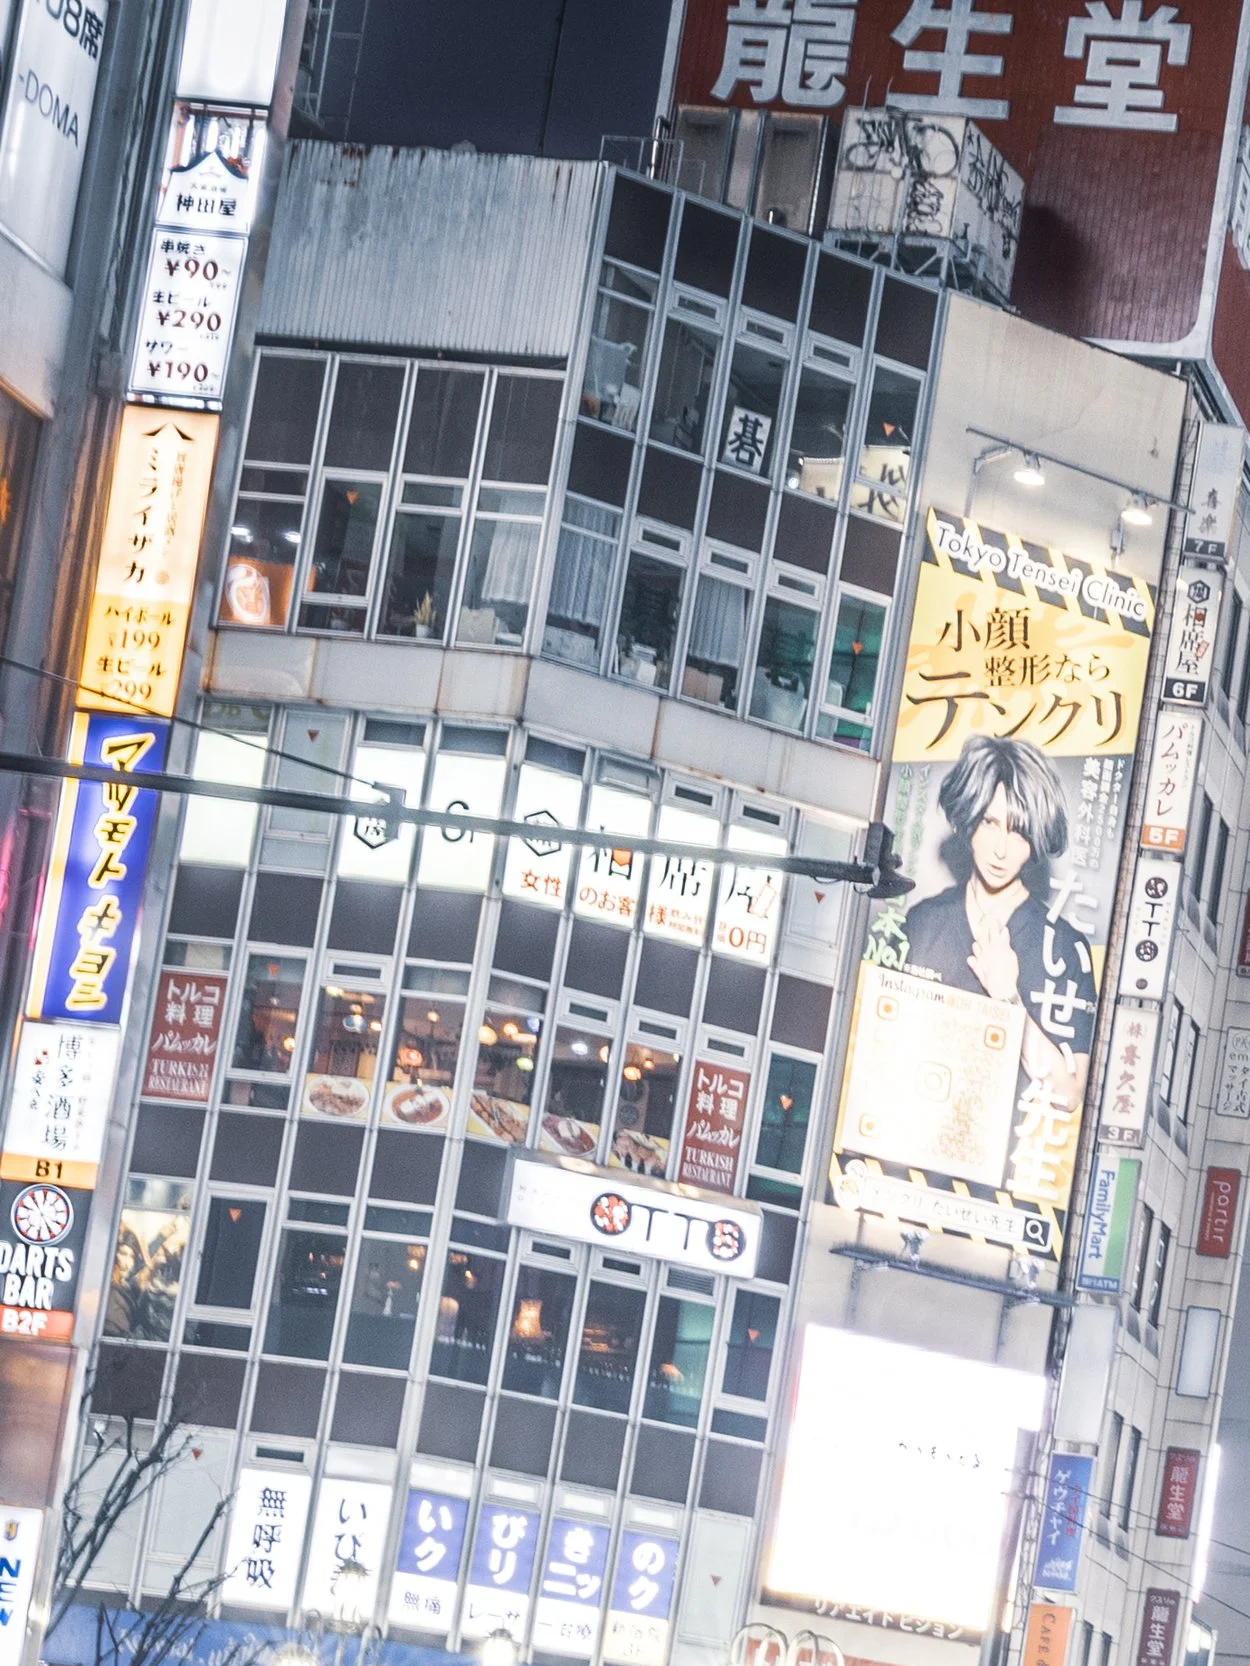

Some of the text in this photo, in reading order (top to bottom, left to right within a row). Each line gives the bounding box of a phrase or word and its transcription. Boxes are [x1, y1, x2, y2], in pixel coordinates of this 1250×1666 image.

[709, 0, 1193, 134] 龍生堂
[156, 309, 222, 332] ¥290
[727, 413, 766, 468] 碁
[123, 447, 158, 584] ミライザカ
[936, 526, 1146, 618] Tokyo Tensei Clinic
[104, 605, 173, 627] ハイボール
[936, 606, 1032, 653] 小顔
[1174, 603, 1212, 678] 相席屋
[96, 654, 166, 677] 生ビール
[984, 652, 1111, 688] 整形なら
[1171, 682, 1199, 700] 6F
[905, 670, 1123, 751] テンクリ
[1155, 722, 1190, 818] パムッカレ
[1148, 829, 1179, 846] 5F
[166, 978, 221, 1005] トルコ
[164, 1002, 216, 1029] 料理
[152, 1030, 216, 1054] パムッカレ
[150, 1056, 210, 1079] TURKISH
[696, 1067, 745, 1101] トルコ
[146, 1076, 210, 1097] RESTAURANT
[695, 1090, 739, 1122] 料理
[686, 1119, 741, 1149] パムッカレ
[35, 1160, 63, 1180] B1
[680, 1162, 733, 1189] RESTAURANT
[684, 1145, 735, 1173] TURKISH
[1088, 1169, 1116, 1259] FamilyMart
[0, 1240, 75, 1282] DARTS
[2, 1272, 56, 1311] BAR
[1, 1311, 49, 1336] B2F
[1046, 1467, 1072, 1548] ゲウチャイ
[1165, 1465, 1191, 1522] 龍生堂
[243, 1487, 288, 1590] 無呼吸
[1036, 1611, 1057, 1657] CAFE
[1146, 1604, 1171, 1662] 龍生堂
